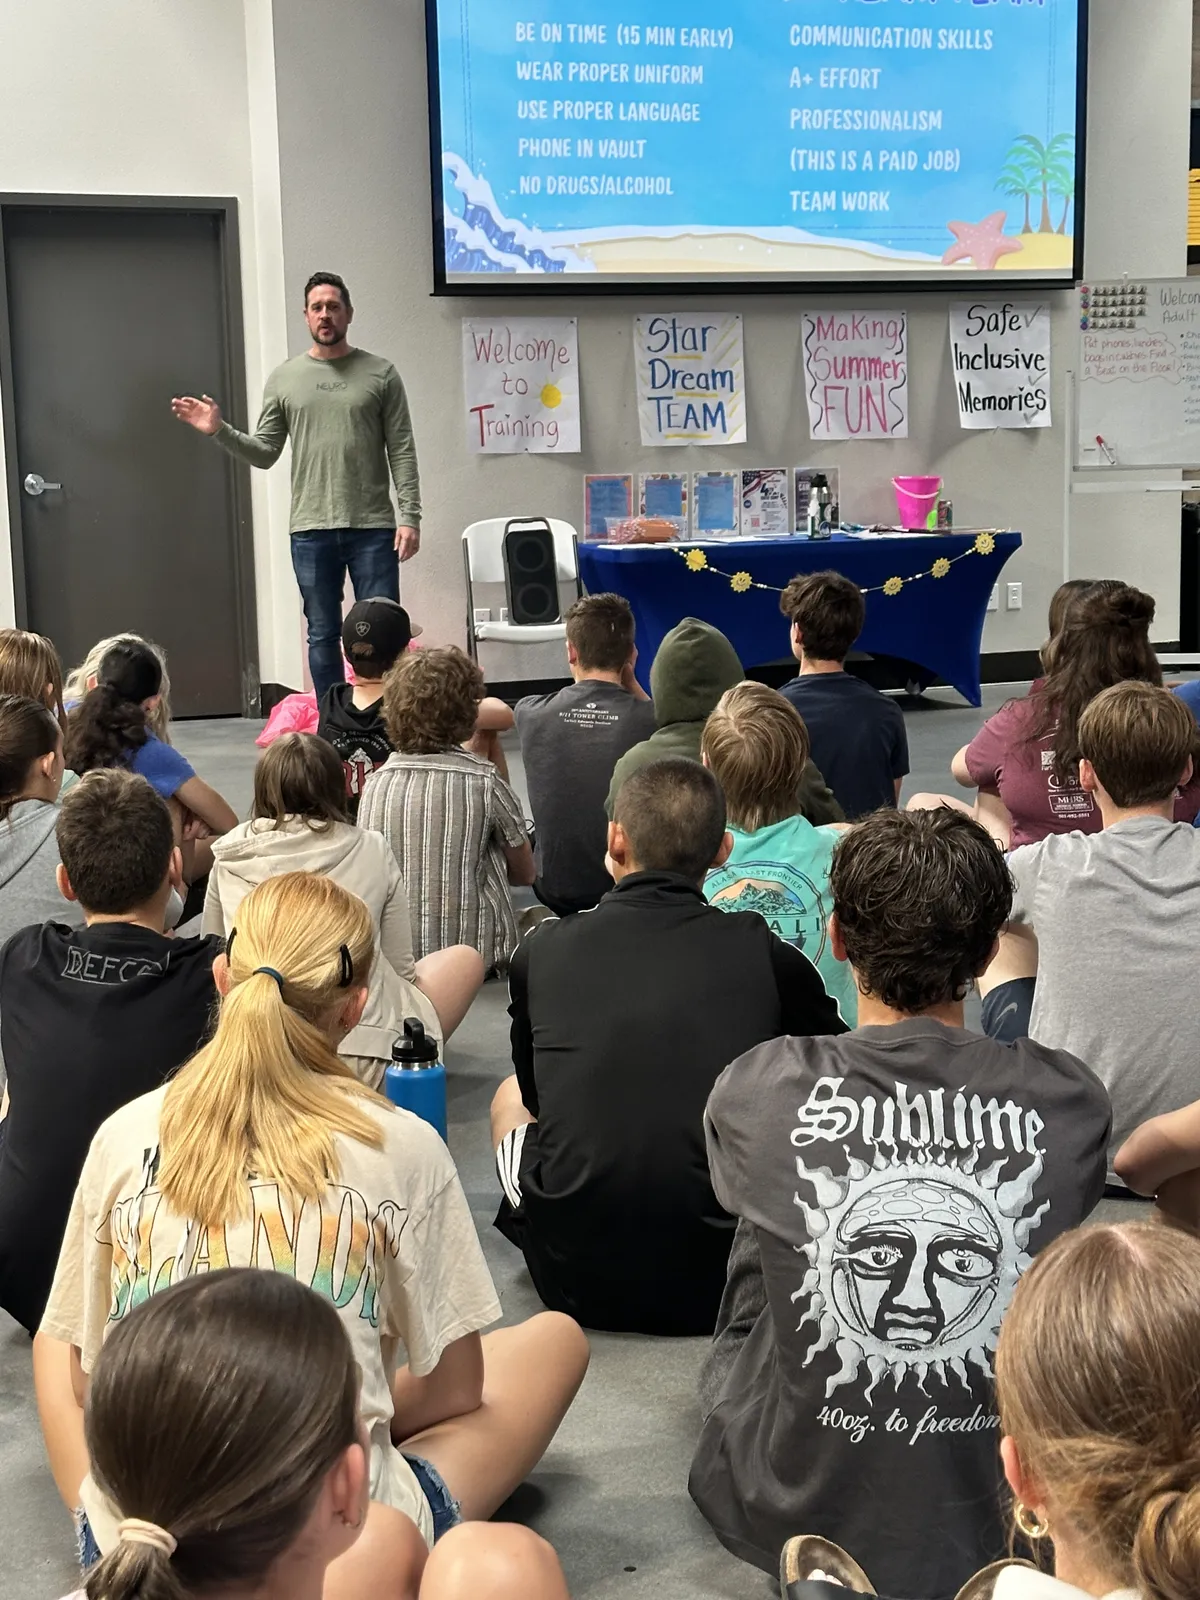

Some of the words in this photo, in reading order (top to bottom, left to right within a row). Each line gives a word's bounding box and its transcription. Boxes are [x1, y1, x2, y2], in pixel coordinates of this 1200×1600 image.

[515, 21, 535, 42] BE
[541, 22, 562, 43] ON
[567, 23, 607, 44] TIME
[617, 23, 640, 45] (15
[646, 25, 675, 46] MIN
[681, 26, 733, 49] EARLY)
[790, 23, 932, 49] COMMUNICATION
[938, 27, 993, 50] SKILLS
[516, 60, 563, 81] WEAR
[568, 61, 629, 83] PROPER
[634, 63, 704, 84] UNIFORM
[789, 66, 813, 89] A+
[819, 67, 882, 89] EFFORT
[517, 99, 548, 119] USE
[553, 100, 613, 121] PROPER
[619, 101, 701, 122] LANGUAGE
[789, 107, 943, 132] PROFESSIONALISM
[518, 137, 572, 157] PHONE
[577, 138, 593, 158] IN
[599, 138, 647, 158] VAULT
[790, 147, 835, 172] (THIS
[841, 150, 857, 171] IS
[862, 150, 873, 171] A
[879, 150, 918, 171] PAID
[923, 148, 961, 172] JOB)
[519, 175, 541, 195] NO
[546, 174, 674, 196] DRUGS/ALCOHOL
[789, 190, 837, 212] TEAM
[841, 190, 890, 212] WORK
[965, 303, 1022, 337] Safe
[1162, 309, 1197, 325] Adult
[647, 318, 718, 353] Star
[816, 315, 899, 349] Making
[471, 326, 571, 372] Welcome
[954, 342, 1047, 371] Inclusive
[648, 358, 734, 392] Dream
[813, 345, 905, 382] Summer
[501, 372, 529, 395] to
[958, 381, 1047, 413] Memories
[647, 396, 728, 434] TEAM
[823, 382, 889, 434] FUN
[469, 404, 559, 448] Training
[767, 870, 803, 891] FRONTIER
[790, 1076, 1047, 1155] Sublime
[816, 1405, 876, 1443] 40oz.
[885, 1407, 909, 1432] to
